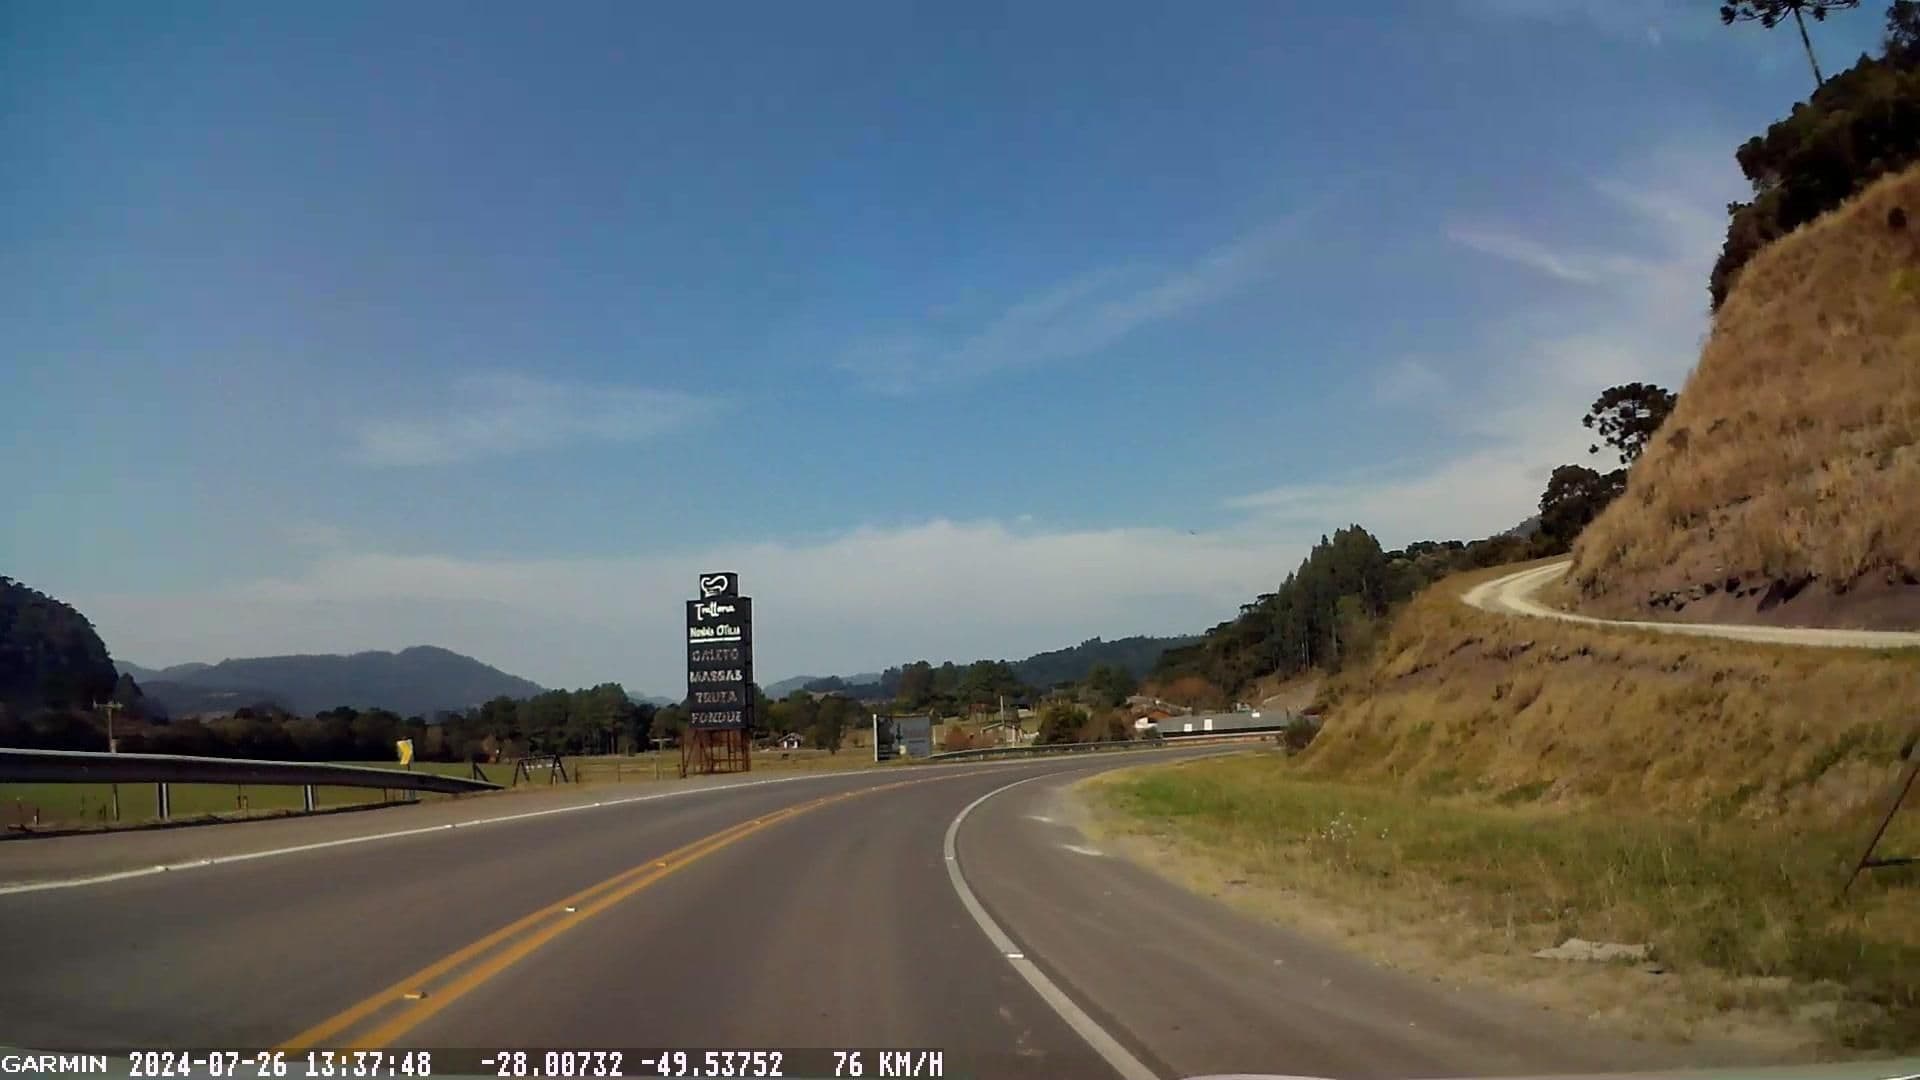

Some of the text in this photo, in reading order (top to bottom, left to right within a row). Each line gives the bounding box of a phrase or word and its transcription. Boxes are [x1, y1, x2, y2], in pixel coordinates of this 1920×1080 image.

[690, 670, 743, 683] MASSAS
[695, 691, 738, 703] TRUTA
[691, 711, 742, 724] FONDUE
